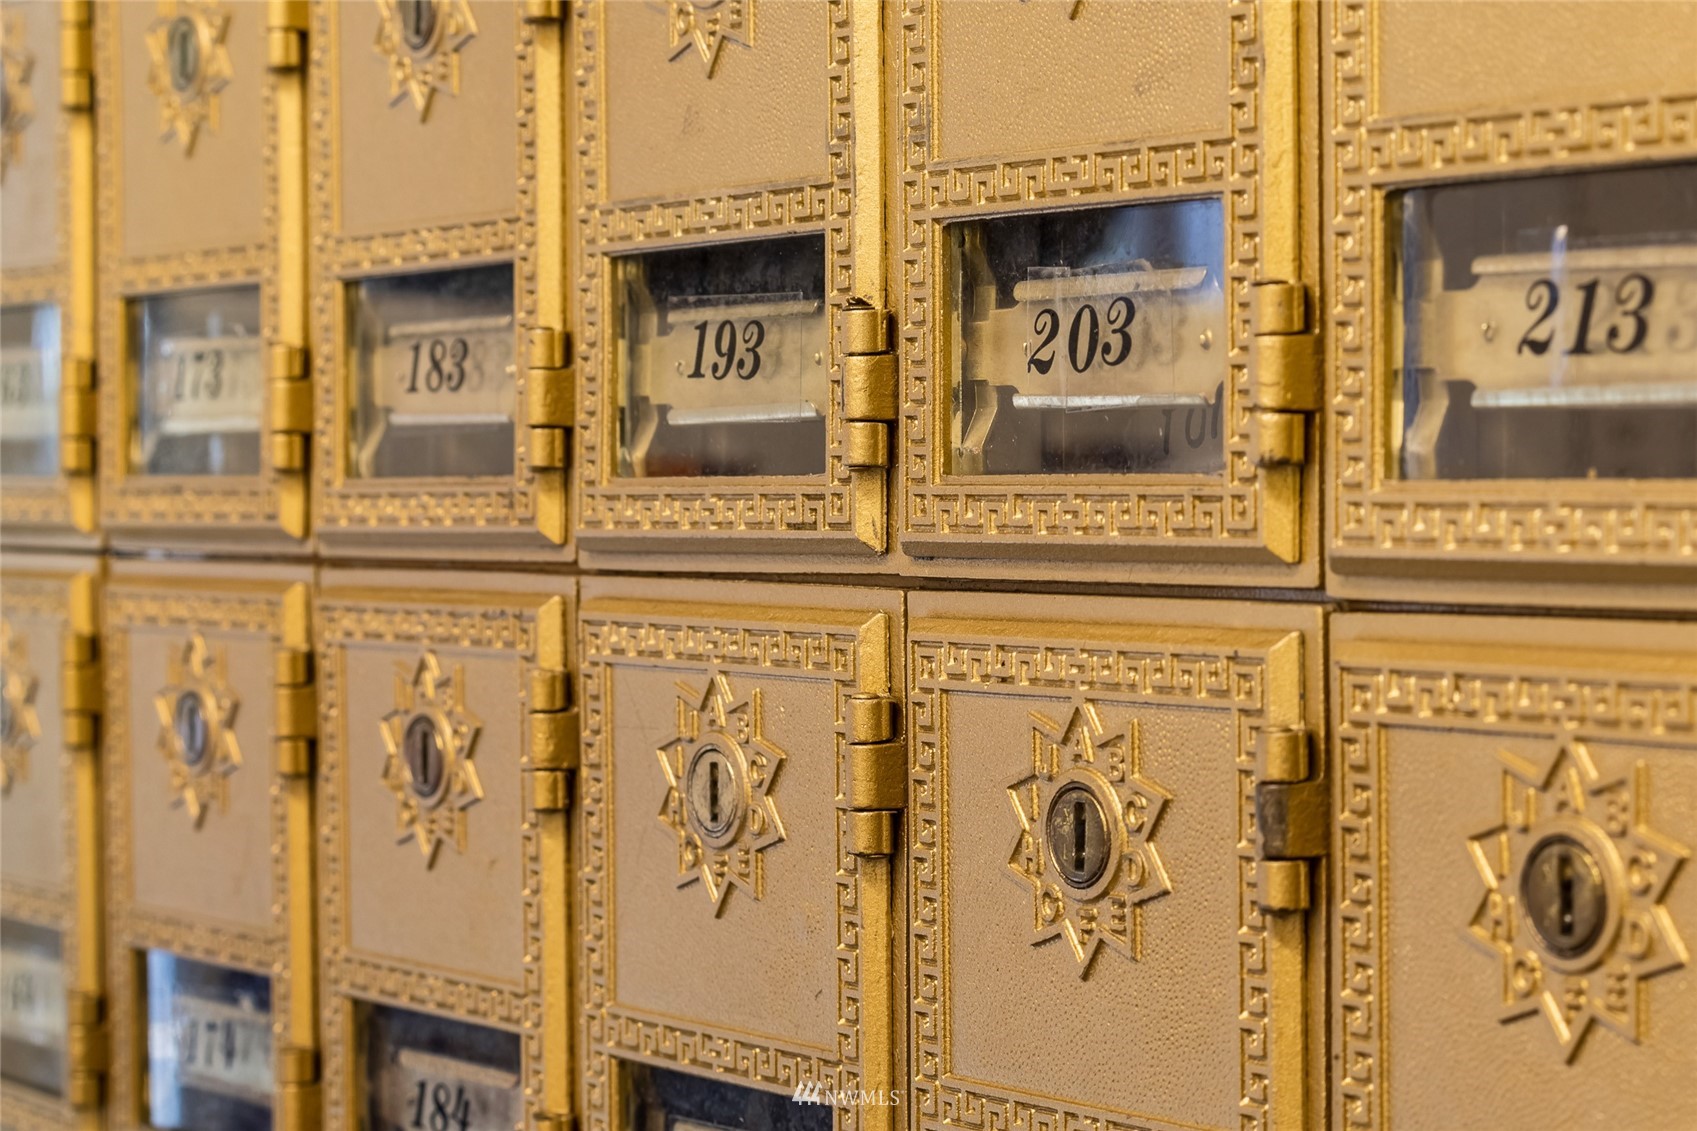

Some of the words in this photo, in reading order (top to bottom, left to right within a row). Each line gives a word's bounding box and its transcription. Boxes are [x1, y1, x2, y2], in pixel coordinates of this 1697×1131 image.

[1027, 296, 1136, 375] 203
[1516, 273, 1656, 357] 213
[404, 337, 470, 394] 183
[687, 319, 765, 381] 193
[411, 1079, 470, 1131] 184
